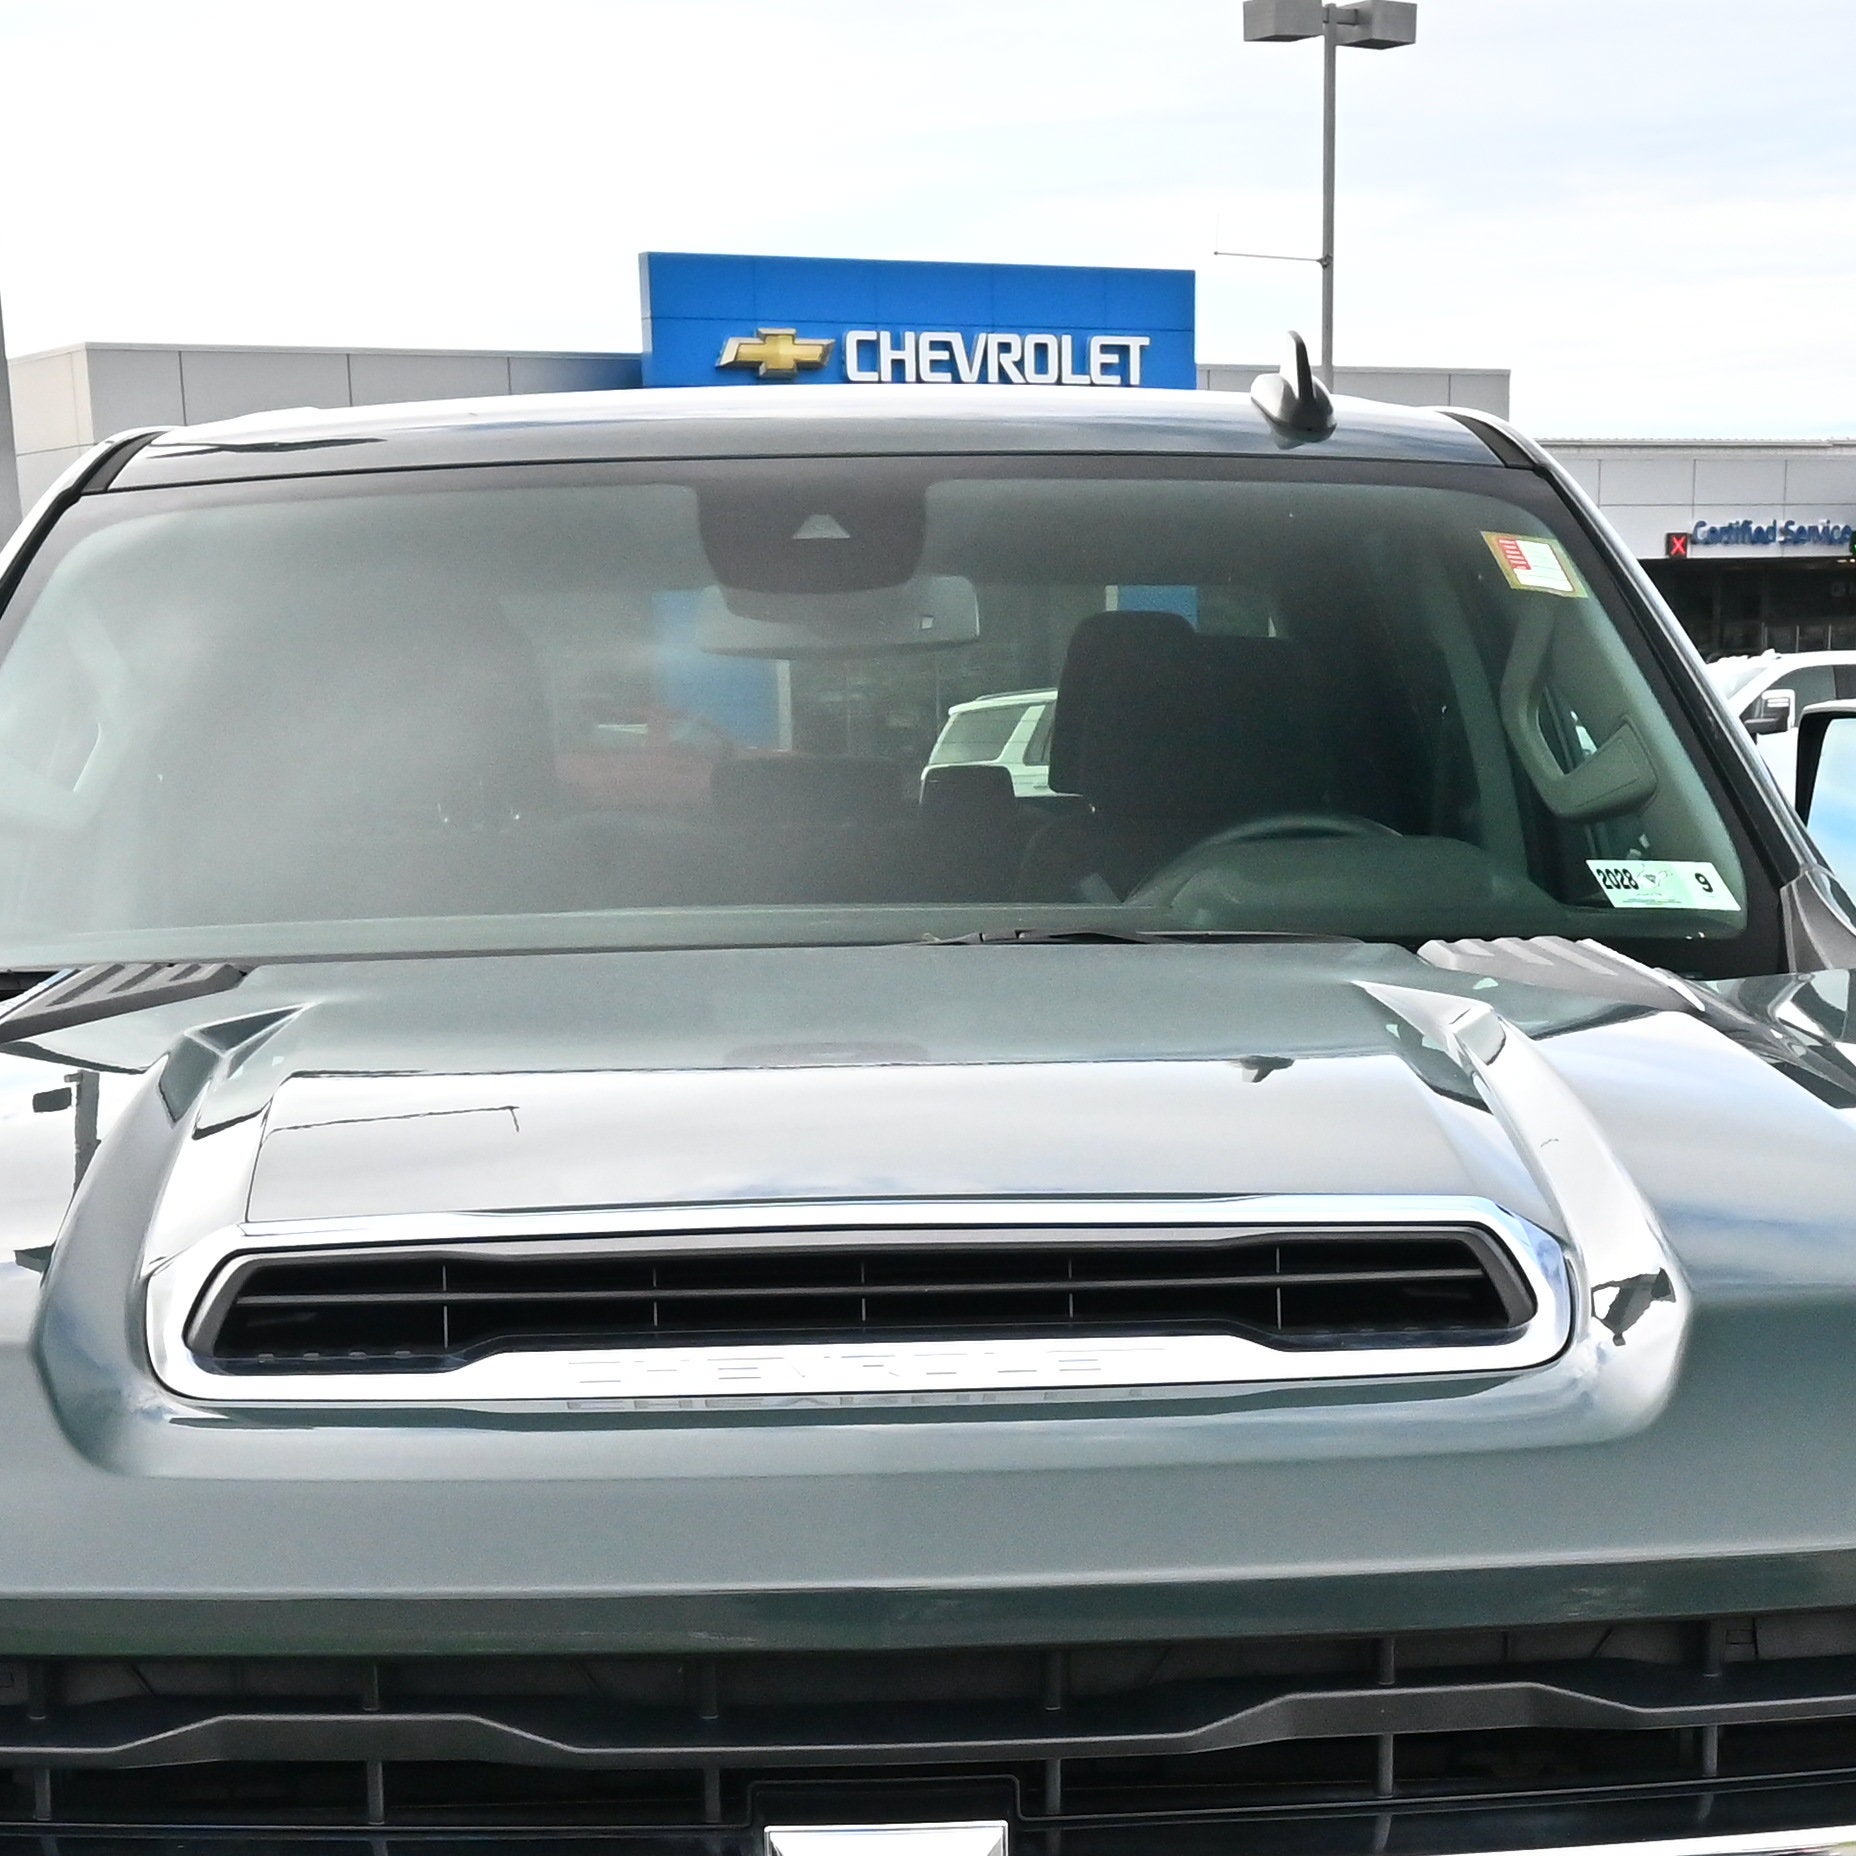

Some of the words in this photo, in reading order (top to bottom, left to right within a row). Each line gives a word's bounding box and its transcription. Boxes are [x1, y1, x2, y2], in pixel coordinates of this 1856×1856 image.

[845, 329, 1151, 386] CHEVROLET
[1692, 519, 1777, 546] Certified
[1778, 519, 1853, 545] Service
[1596, 868, 1640, 890] 2028
[1694, 872, 1714, 893] 9
